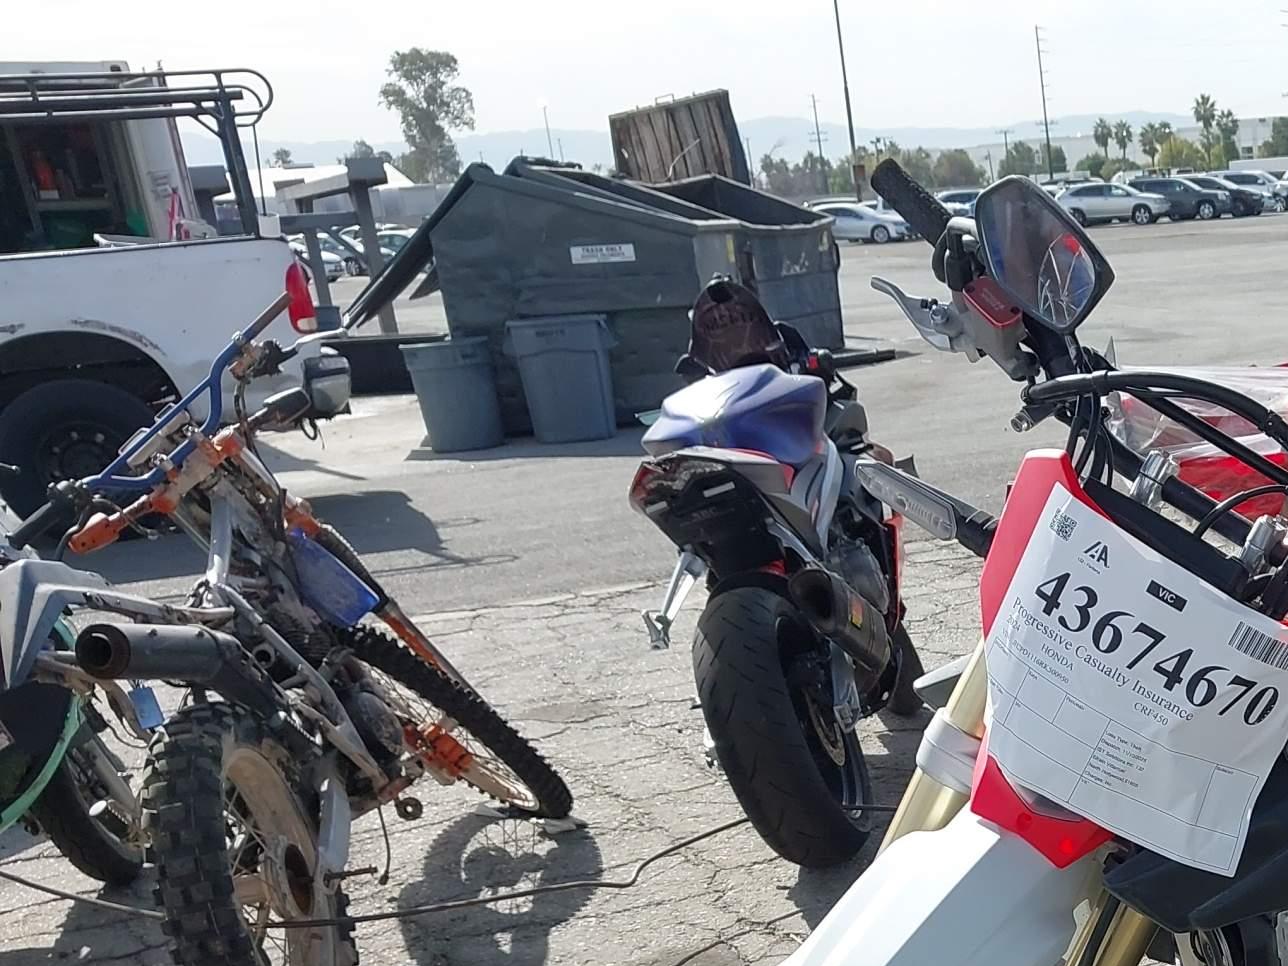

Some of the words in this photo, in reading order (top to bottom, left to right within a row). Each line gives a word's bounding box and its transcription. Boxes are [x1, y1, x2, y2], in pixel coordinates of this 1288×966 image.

[1159, 587, 1176, 603] VIC
[1012, 596, 1073, 651] Progressive
[1075, 645, 1130, 688] Casualty
[1132, 679, 1194, 722] Insurance
[1034, 571, 1280, 726] 43674670
[1041, 642, 1074, 672] HONDA
[1133, 701, 1169, 726] CRF450
